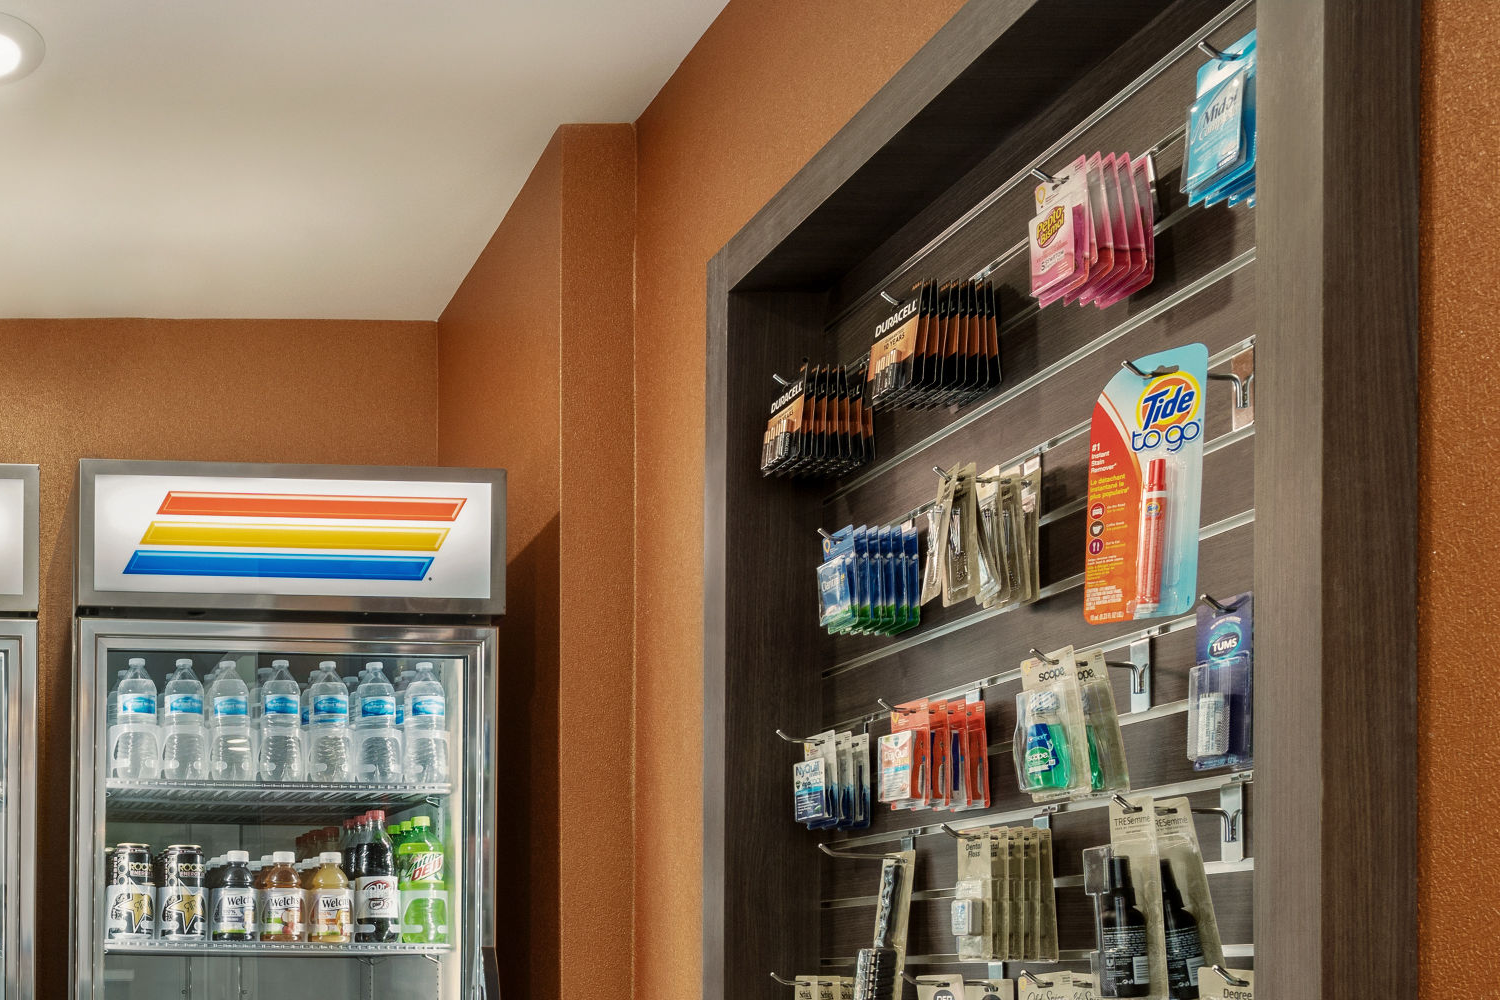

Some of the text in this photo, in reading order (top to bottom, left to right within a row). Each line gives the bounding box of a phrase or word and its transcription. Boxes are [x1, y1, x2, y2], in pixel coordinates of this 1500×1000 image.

[1040, 216, 1064, 247] Bismol
[874, 297, 918, 339] DURACELL
[889, 332, 905, 348] YEARS
[770, 379, 804, 414] DURACELL
[1142, 386, 1195, 431] Tide
[1131, 420, 1201, 452] to go
[1091, 442, 1101, 452] #1
[1091, 450, 1110, 460] Instant
[1091, 459, 1105, 467] Stain
[1090, 478, 1098, 486] Le
[1089, 492, 1102, 502] plus
[1211, 637, 1238, 652] TUMS
[1038, 666, 1065, 682] scope
[1027, 752, 1048, 762] scope
[795, 761, 820, 777] NyQuil
[965, 842, 983, 851] Dental
[967, 850, 981, 858] Floss
[412, 864, 442, 881] DEW
